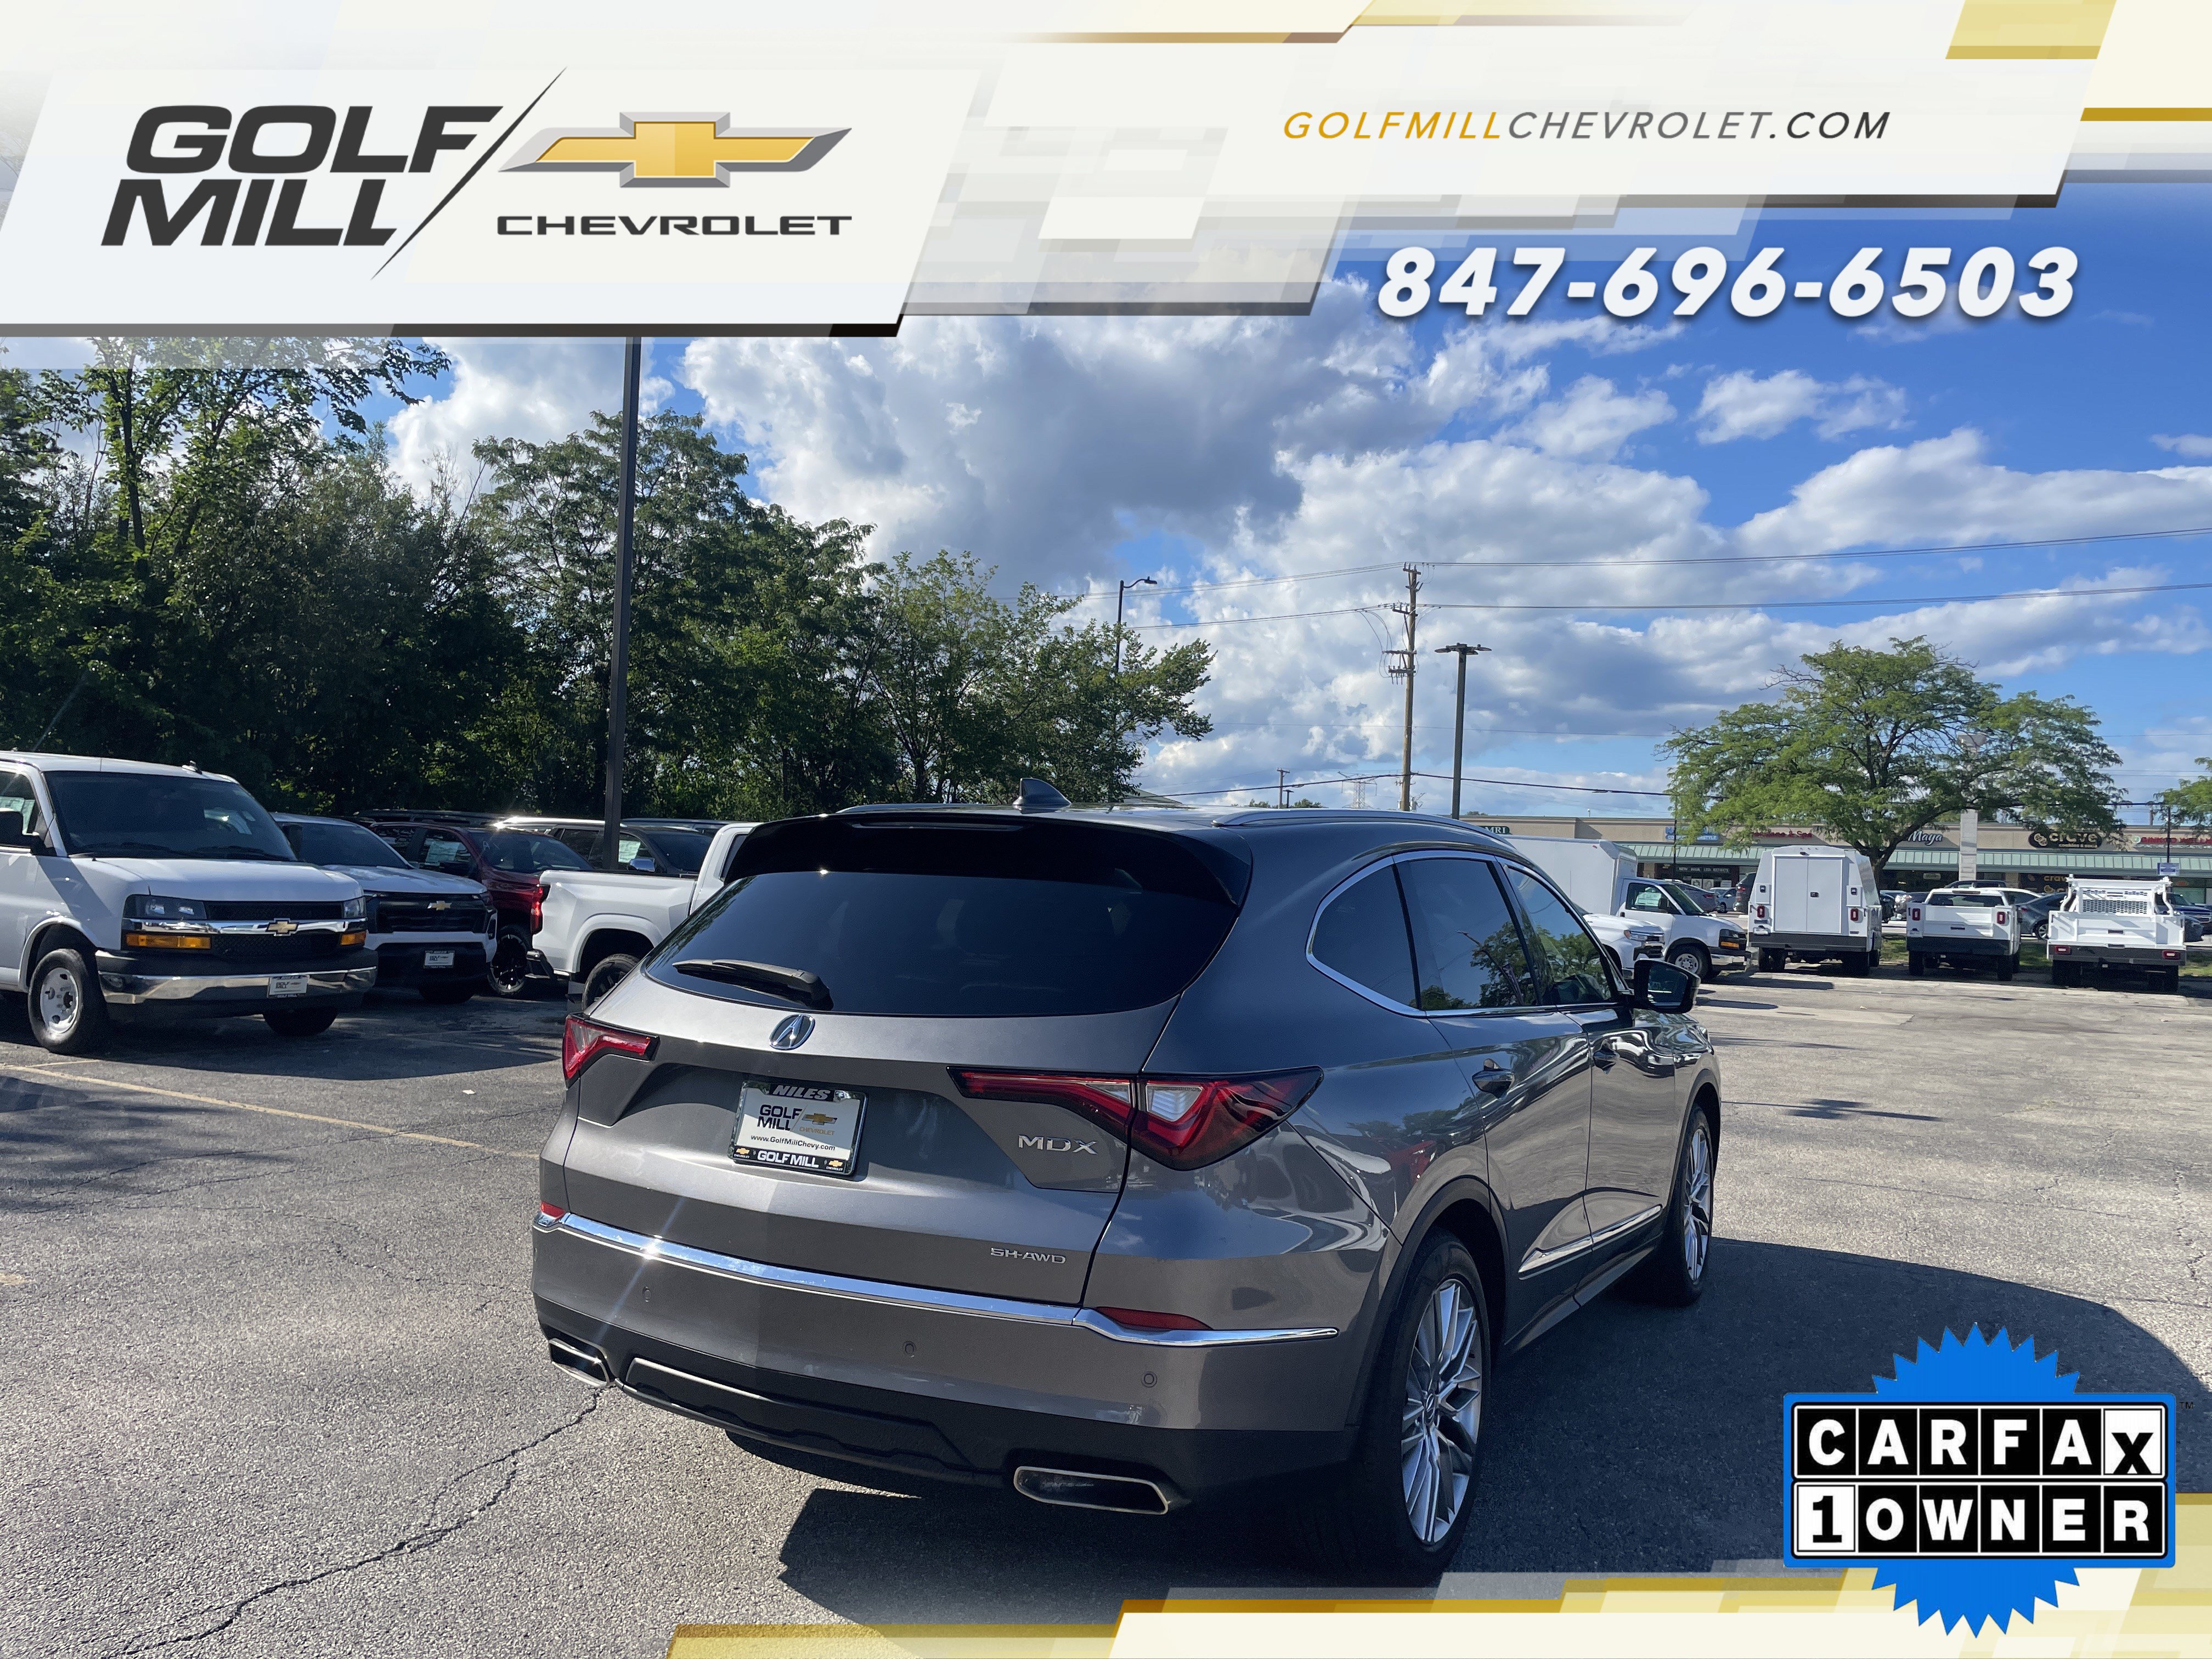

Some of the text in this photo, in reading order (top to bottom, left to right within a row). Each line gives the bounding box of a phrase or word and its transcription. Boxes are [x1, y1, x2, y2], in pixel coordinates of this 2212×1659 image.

[1908, 830, 1943, 845] Maya
[772, 1085, 831, 1100] NILES
[760, 1104, 802, 1120] GOLF
[757, 1116, 791, 1131] MILL
[799, 1126, 836, 1136] CHEVROLET
[751, 1134, 836, 1151] www.GolfMillChevy.com
[1018, 1134, 1098, 1154] MDX
[757, 1150, 819, 1168] GOLF MILL
[990, 1247, 1066, 1264] SH-AWD
